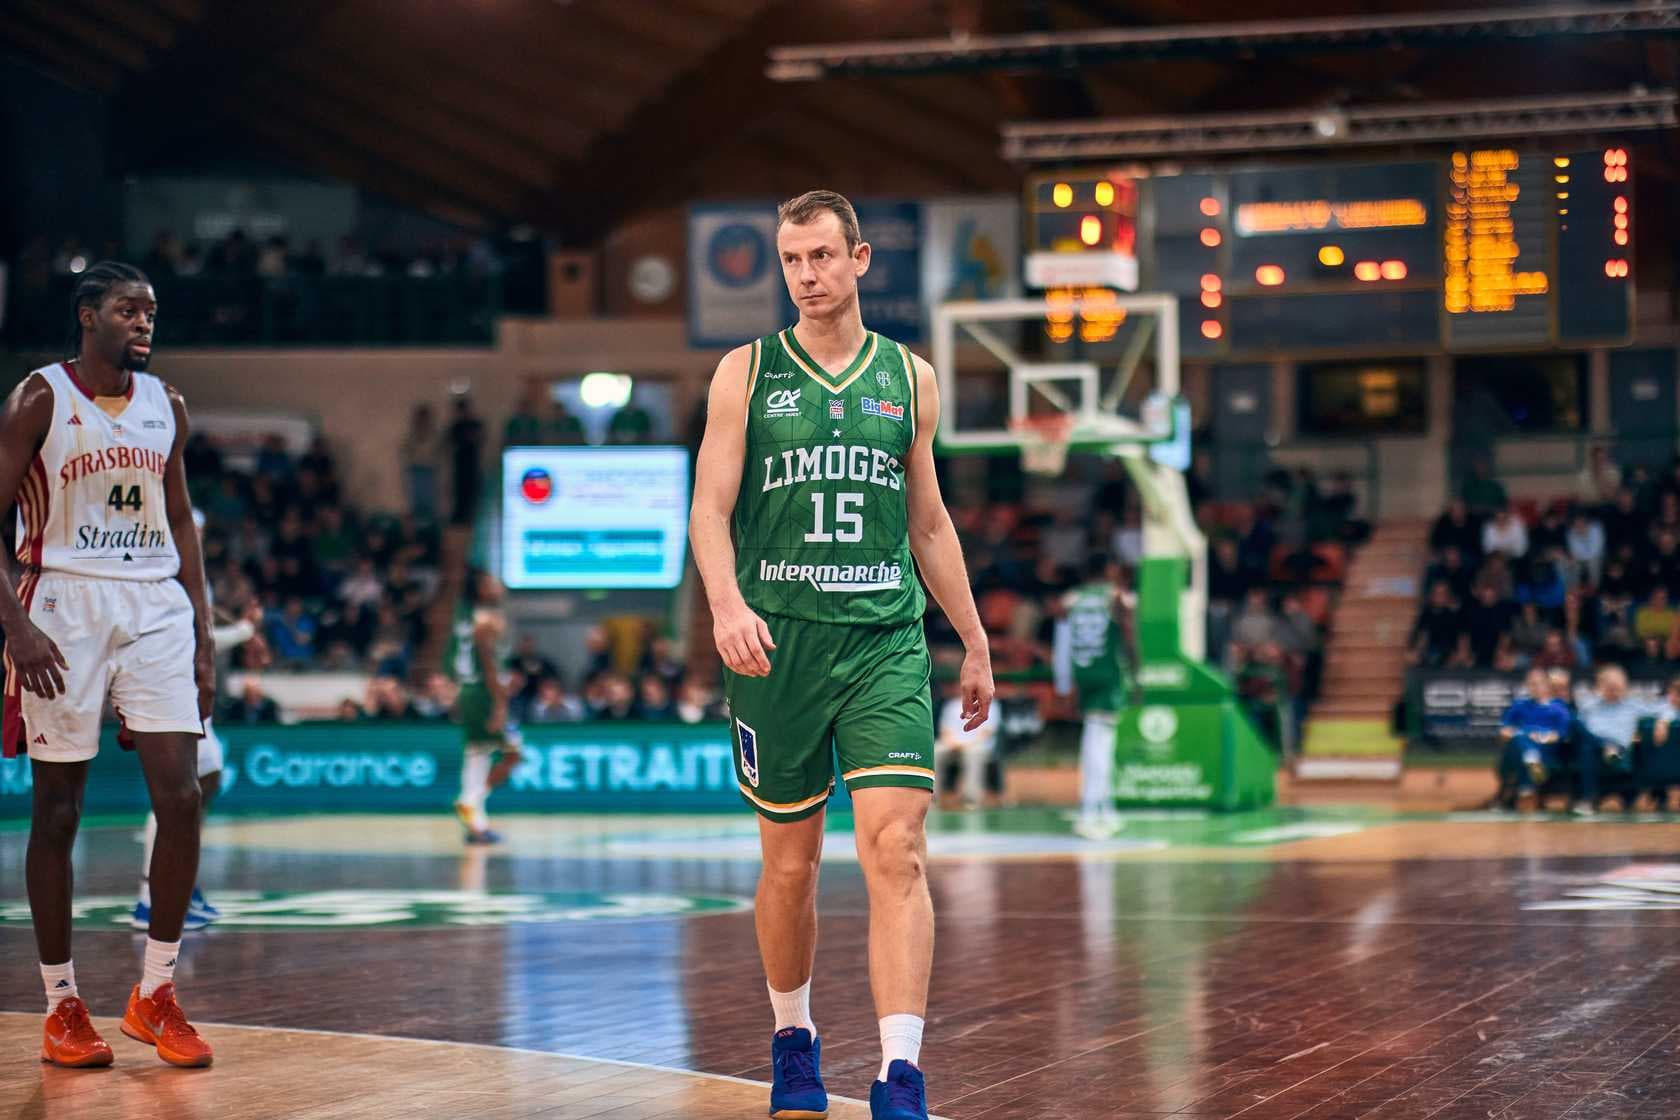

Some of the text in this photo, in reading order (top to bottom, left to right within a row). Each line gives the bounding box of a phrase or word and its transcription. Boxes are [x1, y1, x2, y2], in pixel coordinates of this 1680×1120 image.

[862, 397, 904, 418] BigMat
[763, 445, 900, 493] LIMOGES
[107, 484, 142, 512] 44
[804, 492, 864, 543] 15
[247, 745, 435, 788] Garance
[509, 742, 737, 791] RETRAIT
